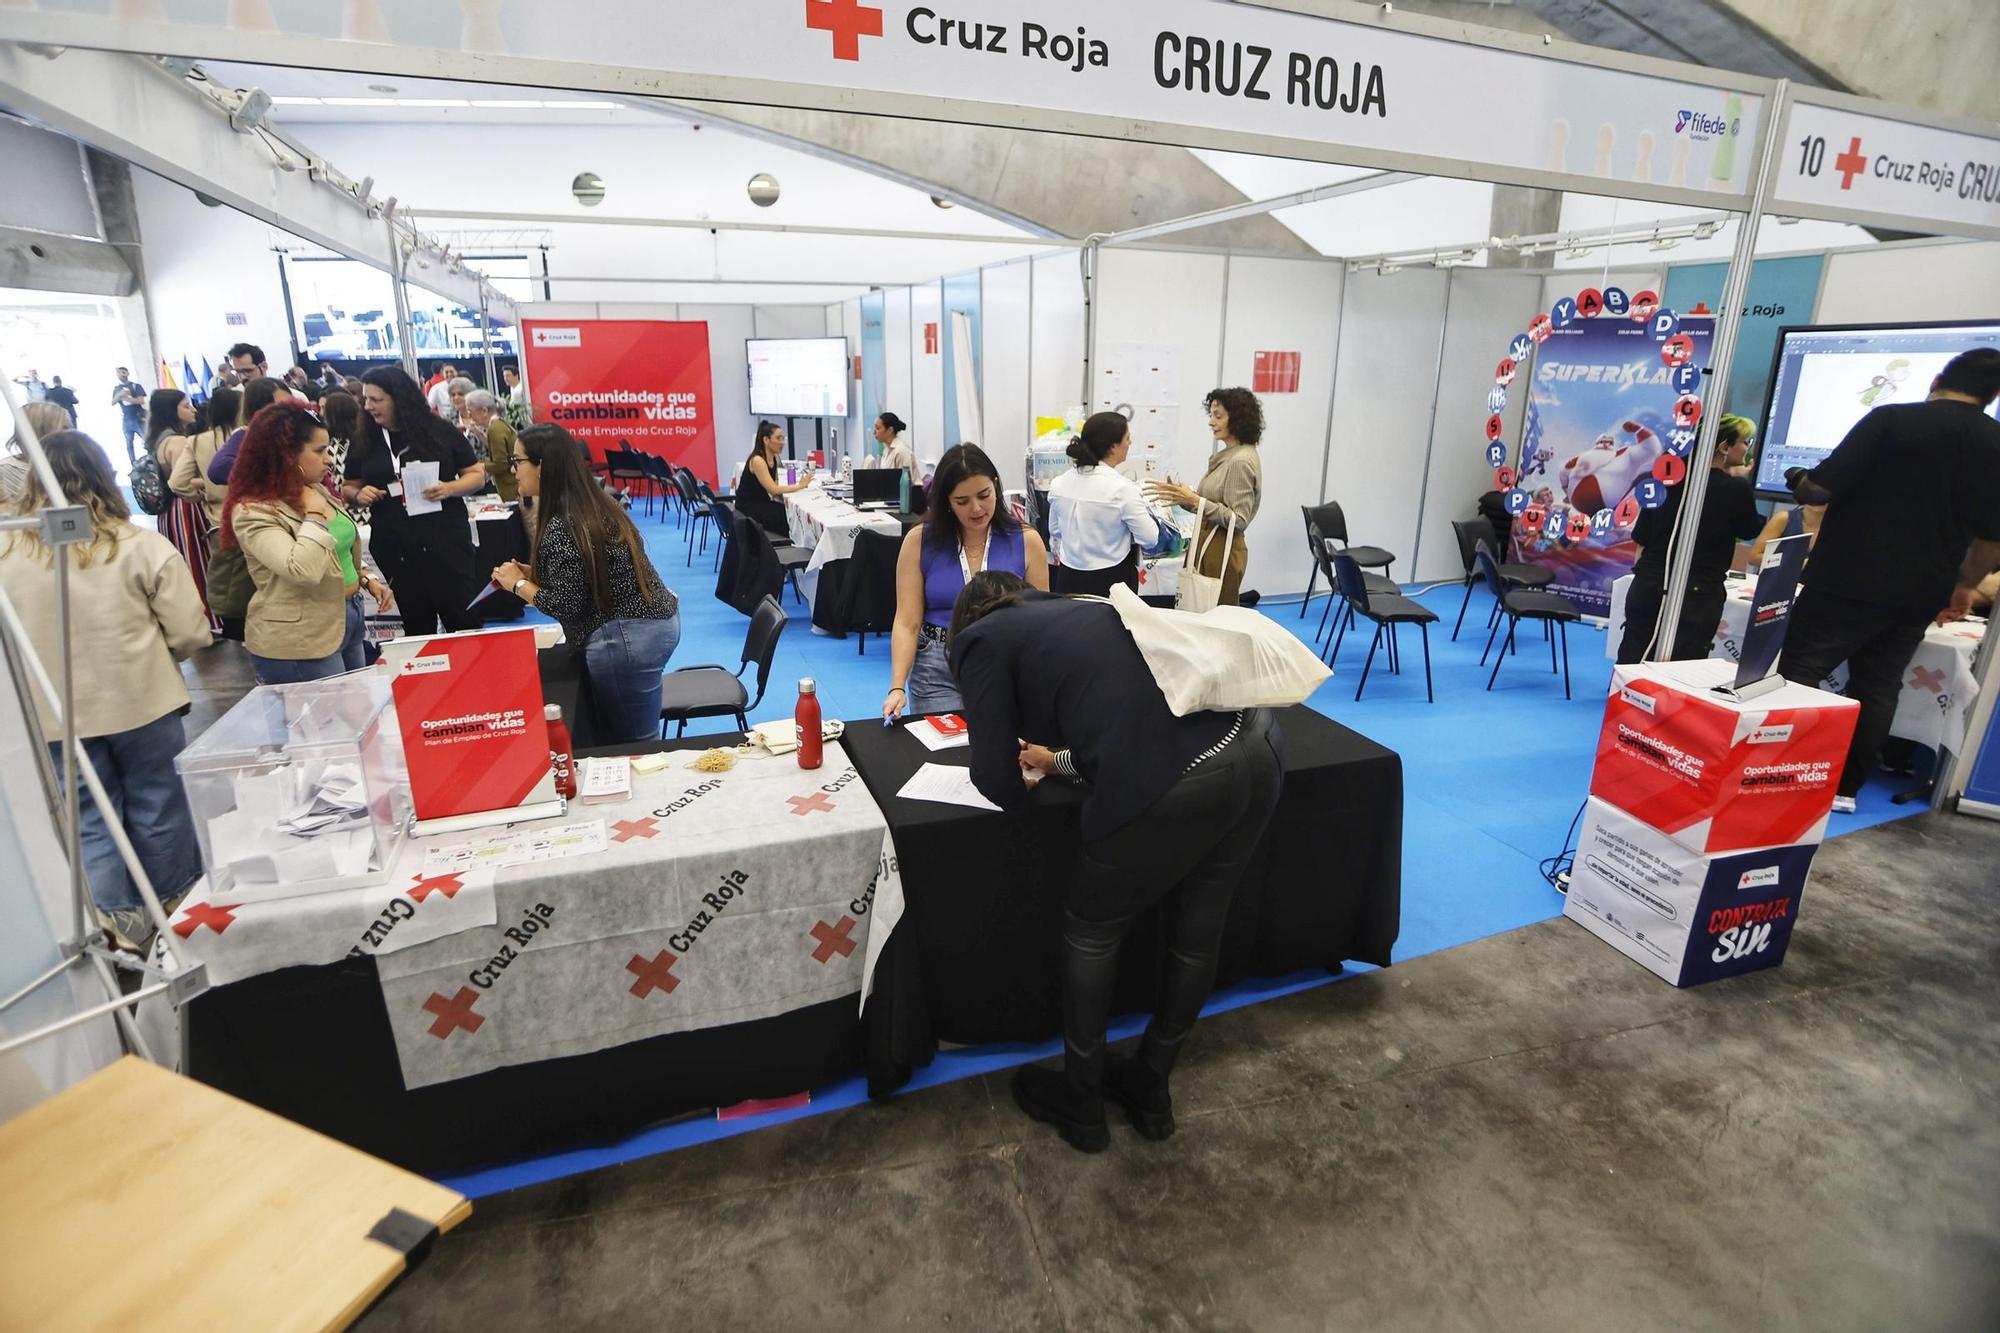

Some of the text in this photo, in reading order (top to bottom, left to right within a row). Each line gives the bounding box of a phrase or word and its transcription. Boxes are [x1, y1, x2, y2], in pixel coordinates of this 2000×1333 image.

[906, 7, 1109, 72] Cruz Roja
[1154, 31, 1386, 117] CRUZ ROJA
[1691, 112, 1726, 135] fifede
[1799, 135, 2000, 204] 10 Cruz Roja CRU
[1584, 295, 1597, 309] A
[1609, 292, 1622, 306] B
[1558, 302, 1570, 319] Y
[1752, 303, 1785, 318] Roja
[1656, 315, 1672, 332] D
[1681, 368, 1692, 385] F
[549, 390, 695, 406] Oportunidades que
[551, 402, 697, 420] cambian vidas
[578, 427, 592, 436] de
[594, 427, 633, 437] Empleo
[635, 426, 648, 436] de
[650, 427, 673, 436] Cruz
[676, 426, 697, 437] Roja
[1490, 419, 1498, 433] S
[1491, 448, 1501, 461] R
[1666, 462, 1671, 476] I
[1644, 484, 1656, 498] J
[1512, 494, 1523, 507] P
[1549, 512, 1562, 532] Ñ
[1596, 514, 1610, 528] M
[432, 660, 445, 668] Roja
[421, 709, 524, 729] Oportunidades que
[423, 717, 525, 739] cambian vidas
[425, 728, 526, 746] Plan de Empleo de Cruz Roja
[1619, 724, 1704, 768] Oportunidades que
[1618, 733, 1702, 779] cambian vidas
[1744, 761, 1831, 776] Oportunidades que
[821, 770, 858, 793] Cruz
[1741, 770, 1828, 786] cambian vidas
[651, 778, 725, 818] Cruz Roja
[850, 872, 879, 915] Cru
[669, 870, 749, 953] Cruz Roja
[361, 897, 416, 947] Cruz
[469, 902, 555, 990] Cruz Roja
